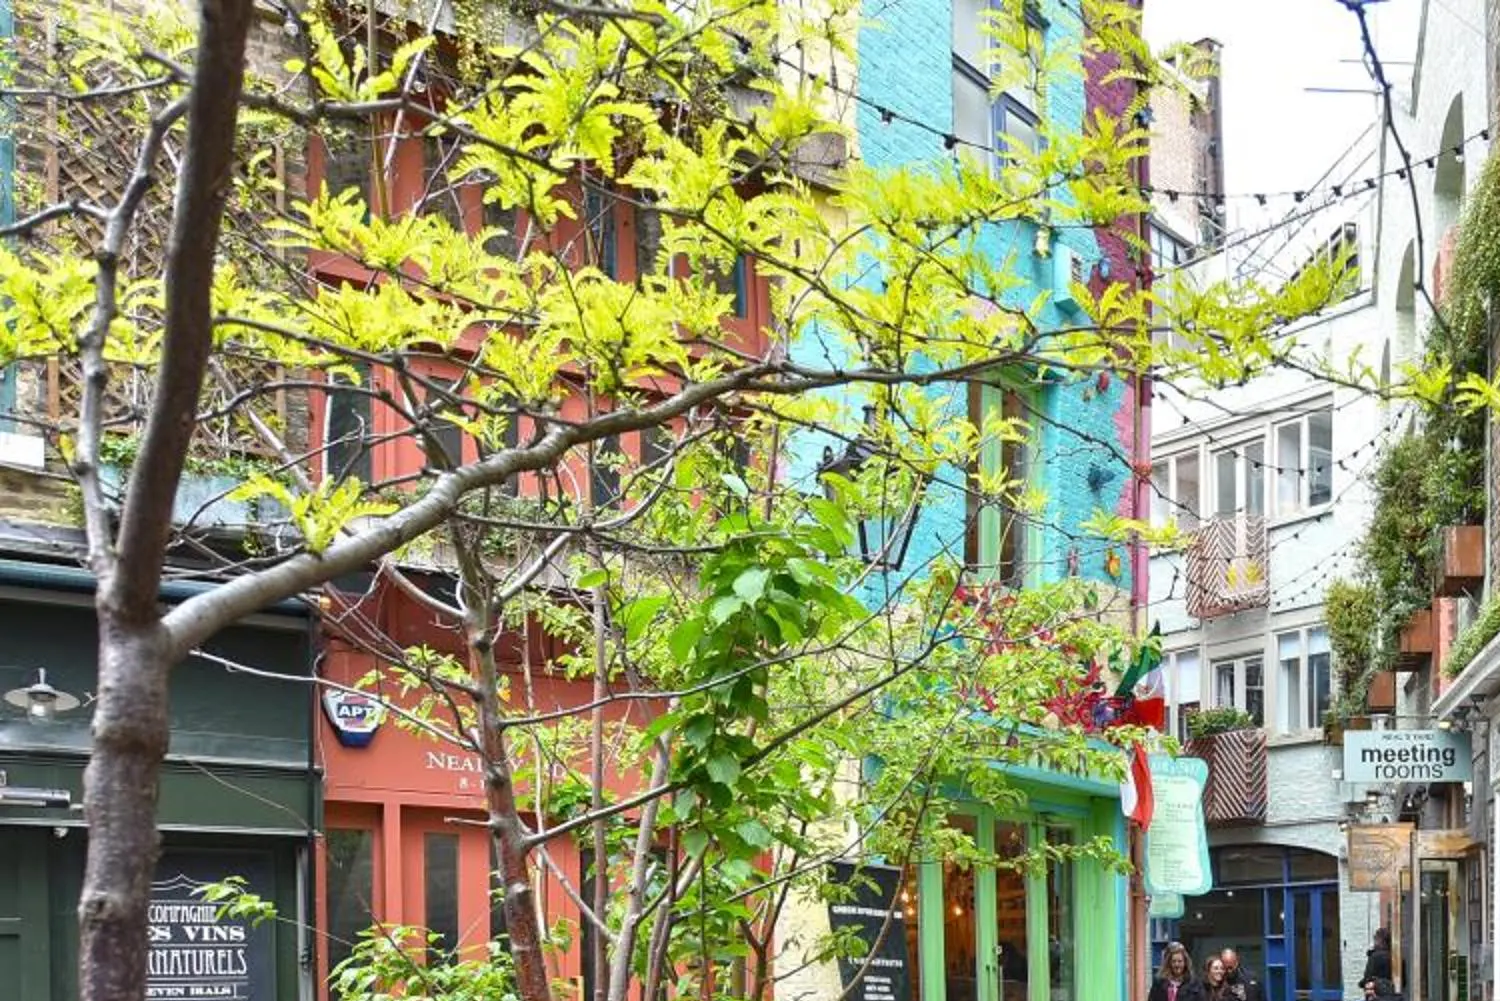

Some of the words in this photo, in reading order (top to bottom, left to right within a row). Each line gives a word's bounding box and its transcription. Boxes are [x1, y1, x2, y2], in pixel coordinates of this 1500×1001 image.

[1361, 744, 1456, 766] meeting
[1375, 763, 1443, 779] rooms
[183, 926, 245, 941] VINS
[146, 987, 185, 996] EVEN
